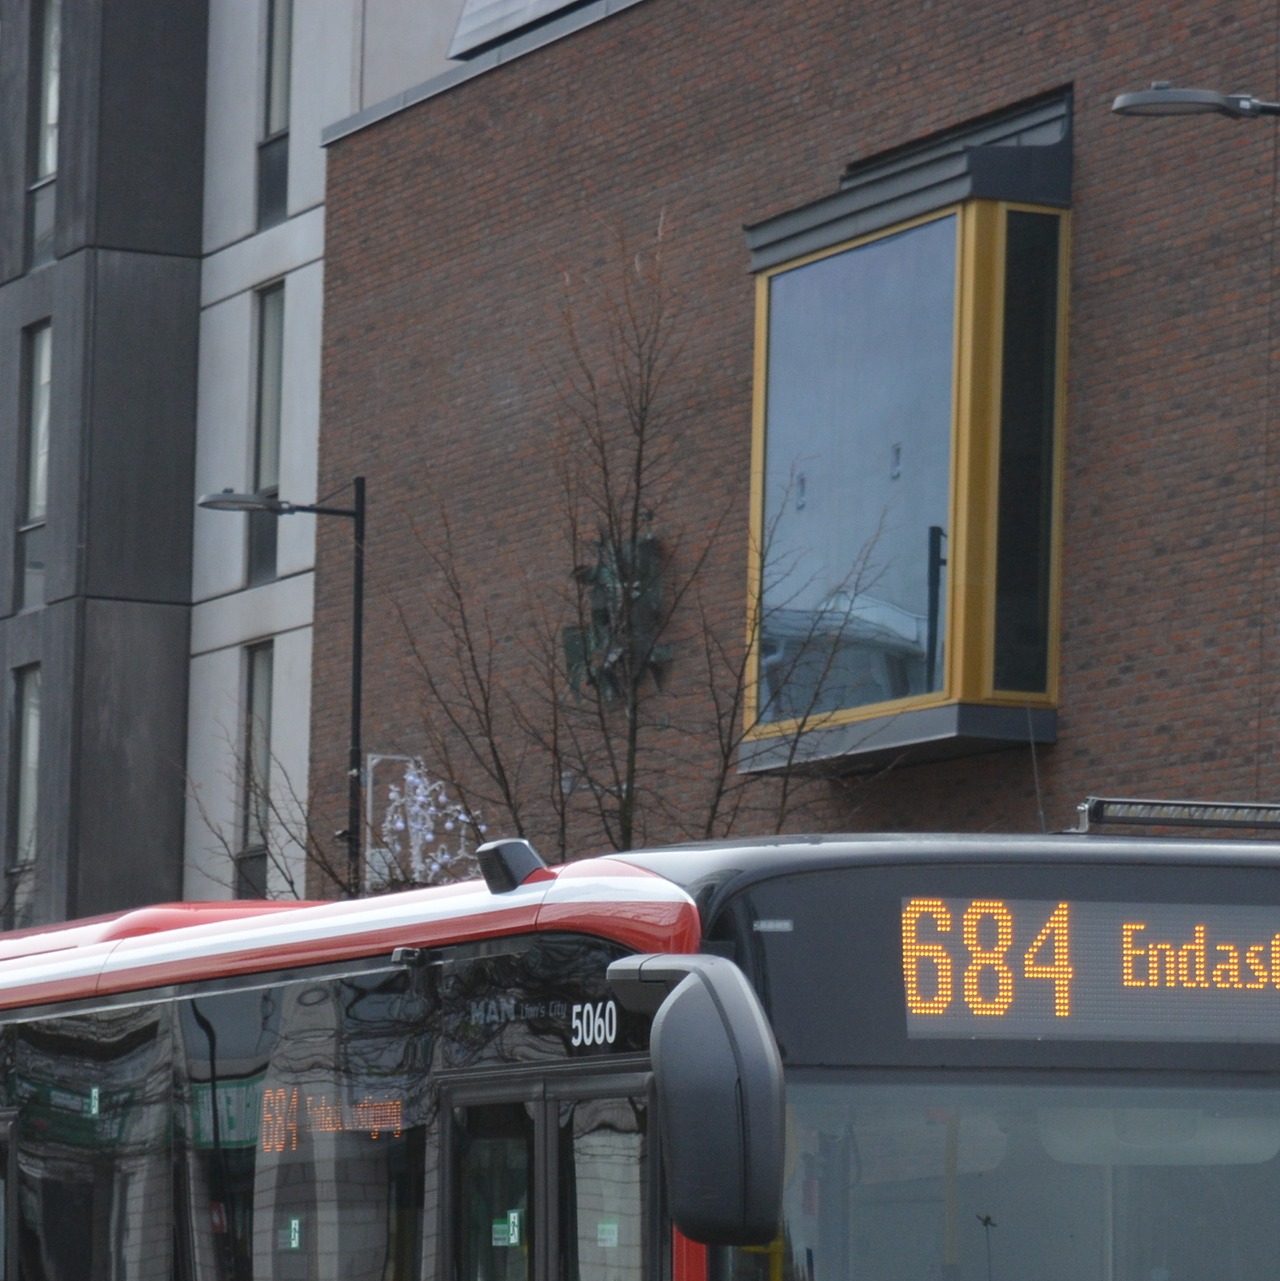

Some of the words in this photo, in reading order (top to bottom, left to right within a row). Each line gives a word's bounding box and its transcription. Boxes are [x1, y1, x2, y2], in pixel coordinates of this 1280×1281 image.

[901, 897, 1073, 1018] 684
[470, 997, 516, 1025] MAN
[572, 1000, 617, 1047] 5060
[262, 1087, 298, 1151] 684
